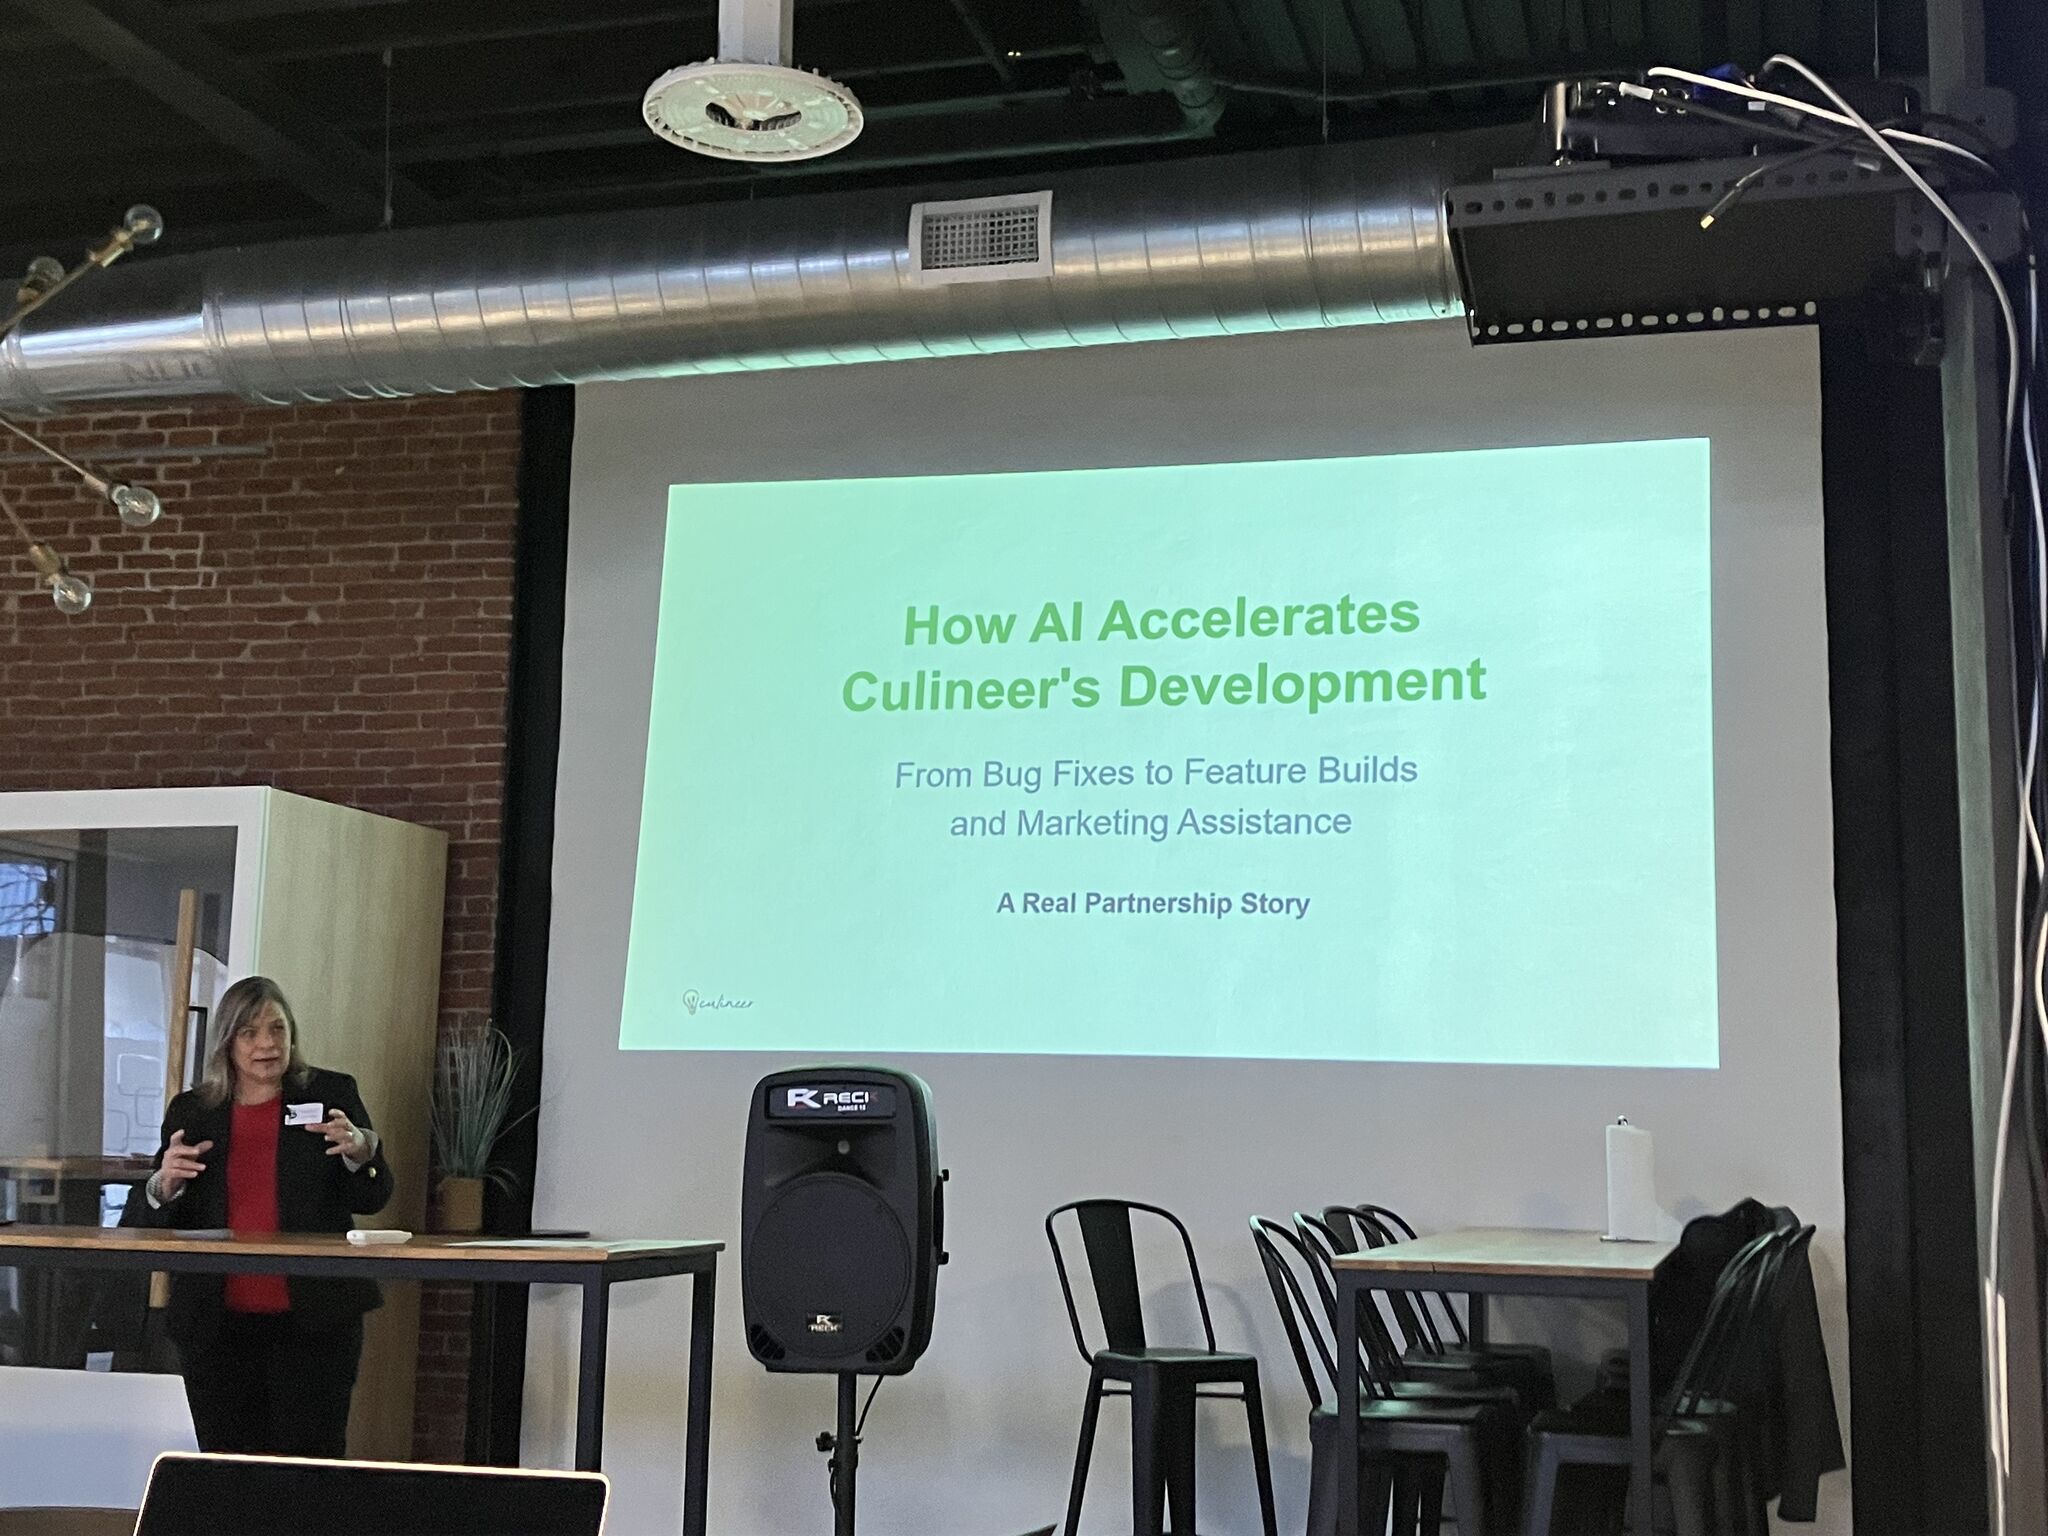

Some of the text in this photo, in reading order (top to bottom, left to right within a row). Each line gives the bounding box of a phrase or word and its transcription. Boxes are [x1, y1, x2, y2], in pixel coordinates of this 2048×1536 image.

[905, 594, 1420, 646] How AI Accelerates
[842, 658, 1487, 714] Culineer's Development
[896, 755, 1418, 794] From Bug Fixes to Feature Builds
[951, 807, 1352, 843] and Marketing Assistance
[996, 891, 1311, 921] A Real Partnership Story
